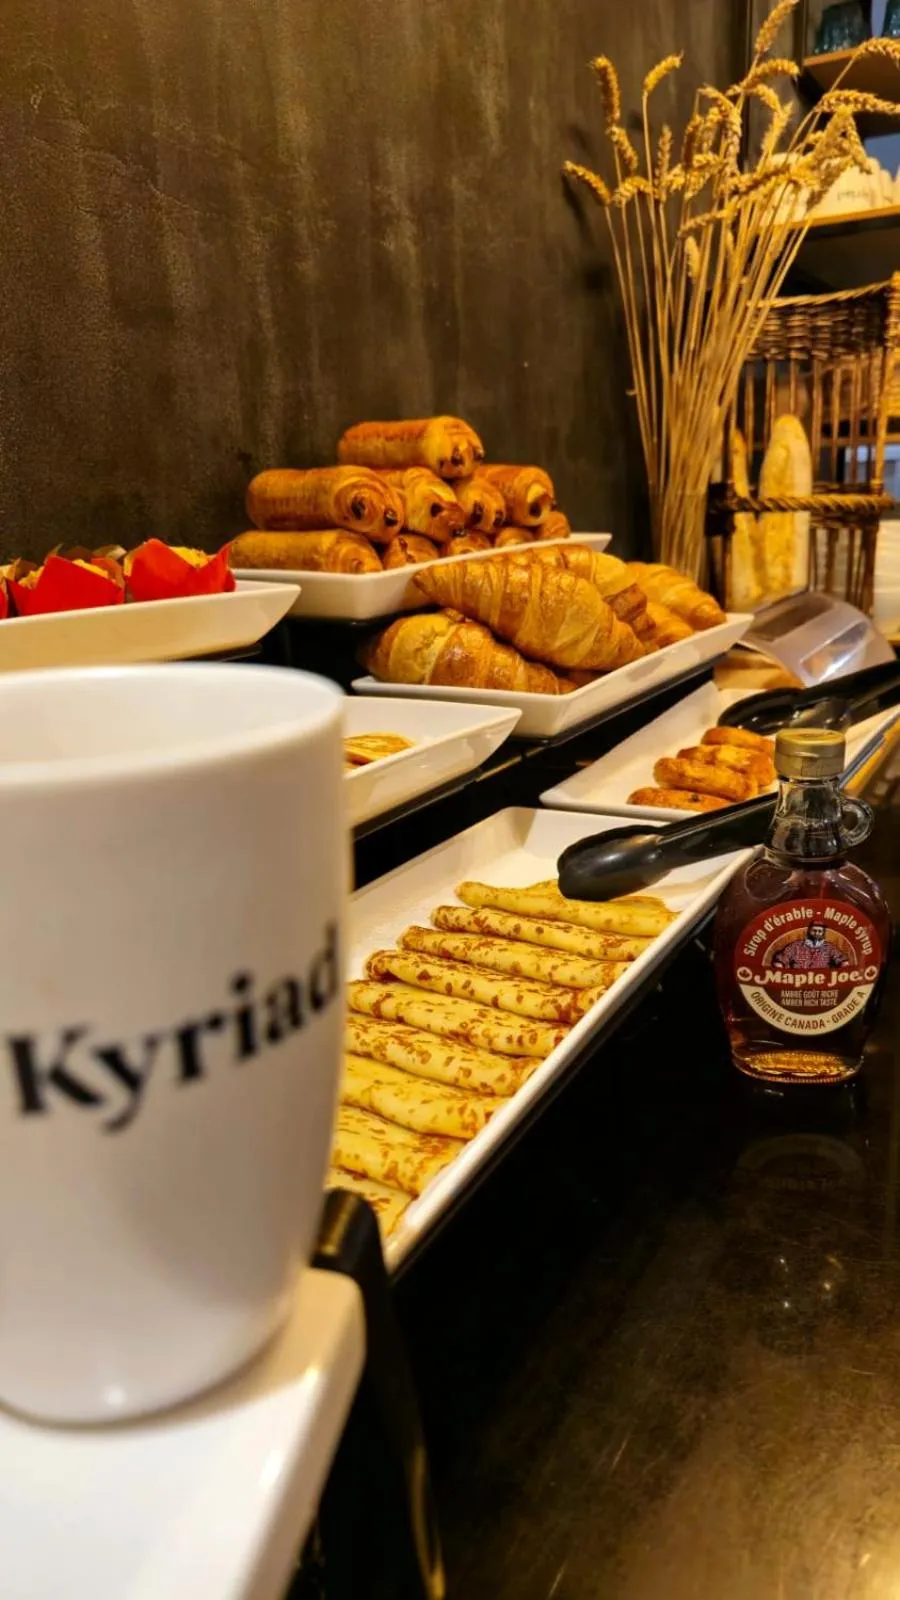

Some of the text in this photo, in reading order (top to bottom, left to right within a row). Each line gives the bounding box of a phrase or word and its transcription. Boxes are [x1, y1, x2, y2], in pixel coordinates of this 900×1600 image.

[743, 928, 768, 957] Sirop
[824, 907, 858, 930] Maple
[854, 926, 874, 956] syrup
[754, 969, 826, 988] Maple
[8, 922, 340, 1133] Kyriad
[750, 991, 788, 1023] ORIGINE
[784, 1015, 826, 1030] CANADA
[831, 999, 860, 1024] GRADE
